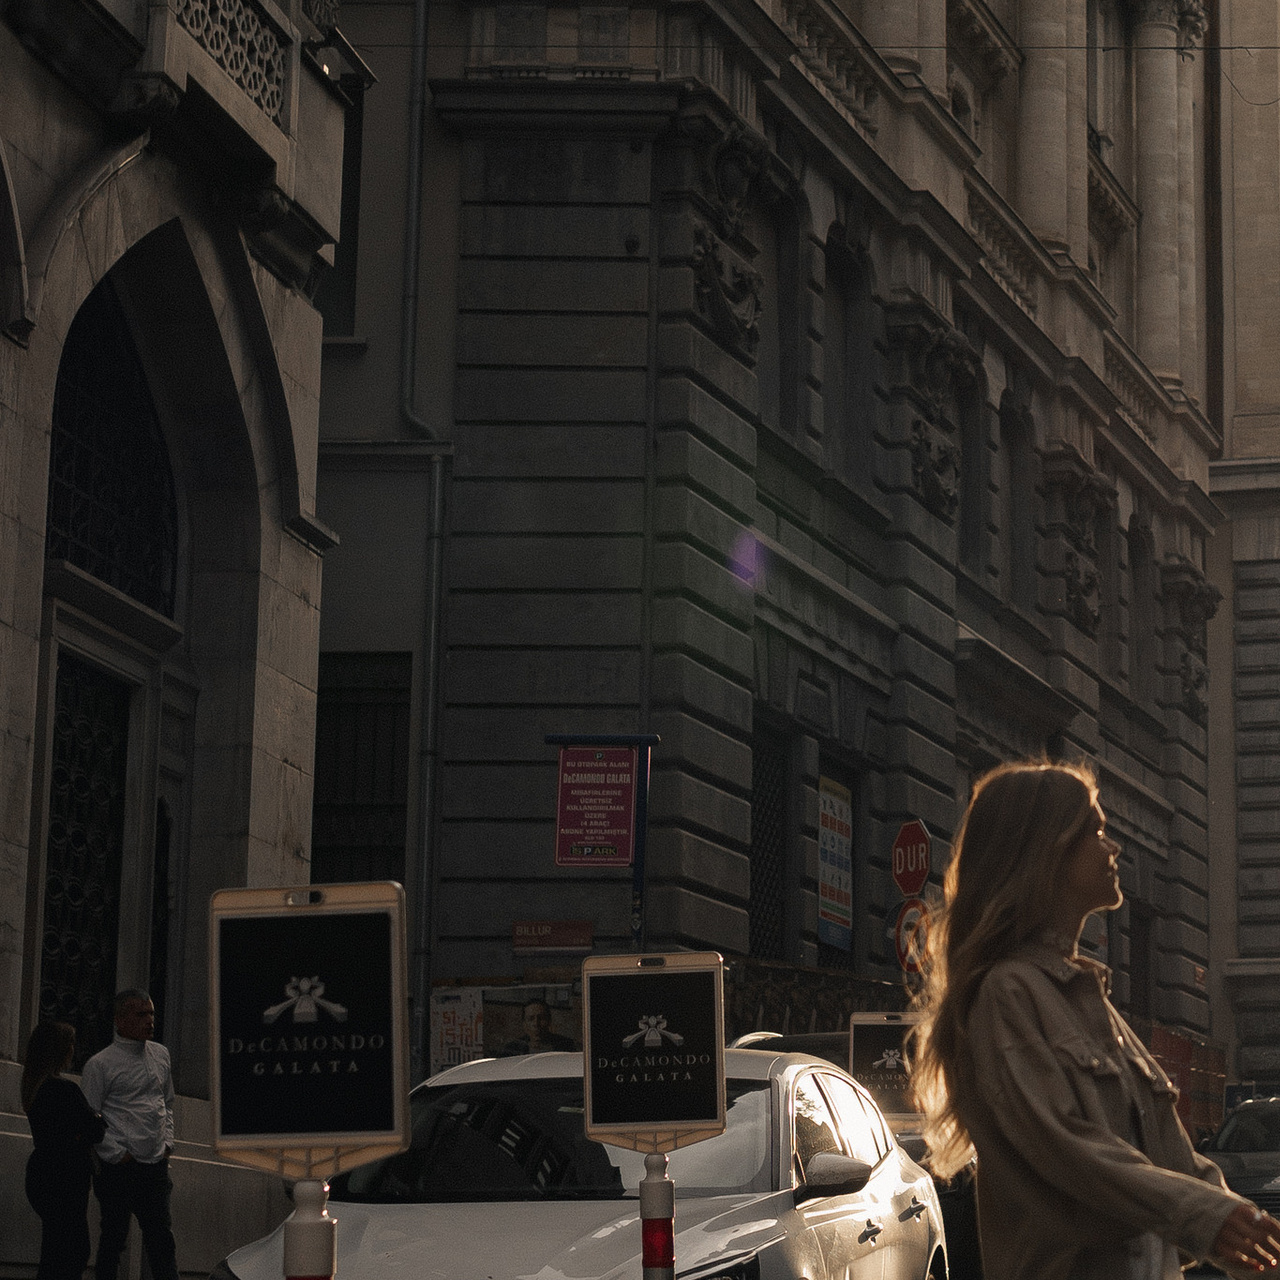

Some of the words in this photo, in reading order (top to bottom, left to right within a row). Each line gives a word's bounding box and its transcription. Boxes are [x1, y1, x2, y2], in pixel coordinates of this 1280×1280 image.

[606, 773, 631, 783] GALATA
[896, 842, 927, 875] DUR
[229, 1034, 384, 1054] DeCAMONDO
[253, 1060, 360, 1076] GALATA
[598, 1054, 711, 1069] DeCAMONDO
[615, 1072, 692, 1083] GALATA
[857, 1073, 909, 1081] DeCAMON
